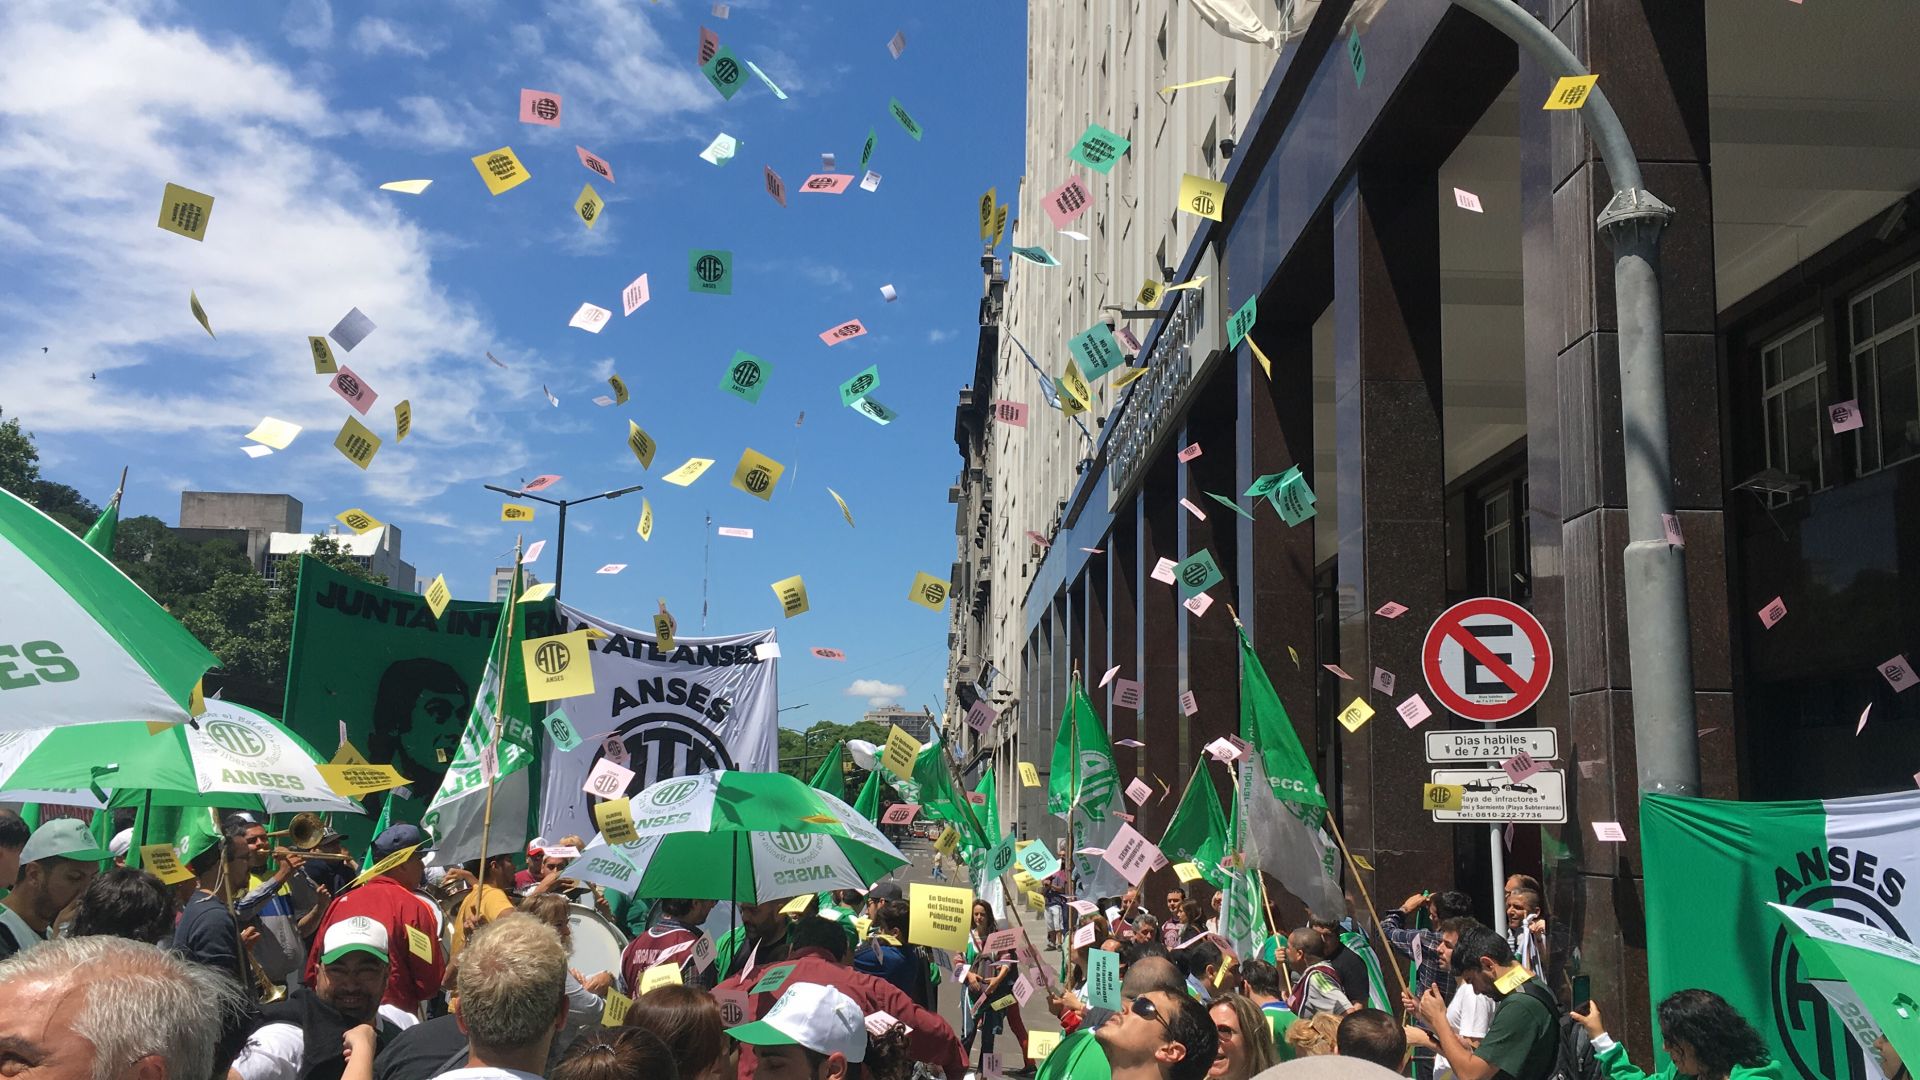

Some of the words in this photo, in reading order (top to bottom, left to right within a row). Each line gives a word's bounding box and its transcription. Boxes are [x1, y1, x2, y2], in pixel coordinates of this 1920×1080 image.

[1192, 196, 1215, 215] ATE
[697, 255, 723, 282] ATE
[733, 361, 760, 387] ATE
[746, 470, 770, 493] ATE
[1183, 563, 1208, 588] ATE
[316, 579, 442, 632] JUNTA
[535, 641, 570, 675] ATE
[546, 675, 564, 684] ANSES
[611, 676, 734, 725] ANSES
[206, 720, 266, 757] ATE
[1455, 736, 1480, 746] Dias
[1484, 735, 1527, 744] habiles
[1455, 746, 1468, 756] de
[1472, 746, 1478, 755] 7
[1482, 748, 1489, 756] a
[1493, 746, 1506, 754] 21
[1510, 746, 1525, 754] hs
[222, 768, 306, 790] ANSES
[594, 774, 620, 794] ATE
[1269, 773, 1308, 794] ecc.
[652, 780, 699, 806] ATE
[1430, 786, 1452, 804] ATE
[1462, 796, 1479, 804] laya
[636, 812, 692, 829] NSES
[889, 809, 910, 822] ATE
[1026, 852, 1046, 872] ATE
[1774, 846, 1907, 908] ANSES
[928, 894, 936, 902] En
[938, 895, 964, 905] Defensa
[928, 902, 938, 910] del
[939, 904, 964, 914] Sistema
[929, 911, 953, 922] Público
[954, 916, 962, 924] de
[932, 921, 957, 932] Reparto
[696, 938, 709, 958] ATE
[720, 1002, 744, 1024] ATE
